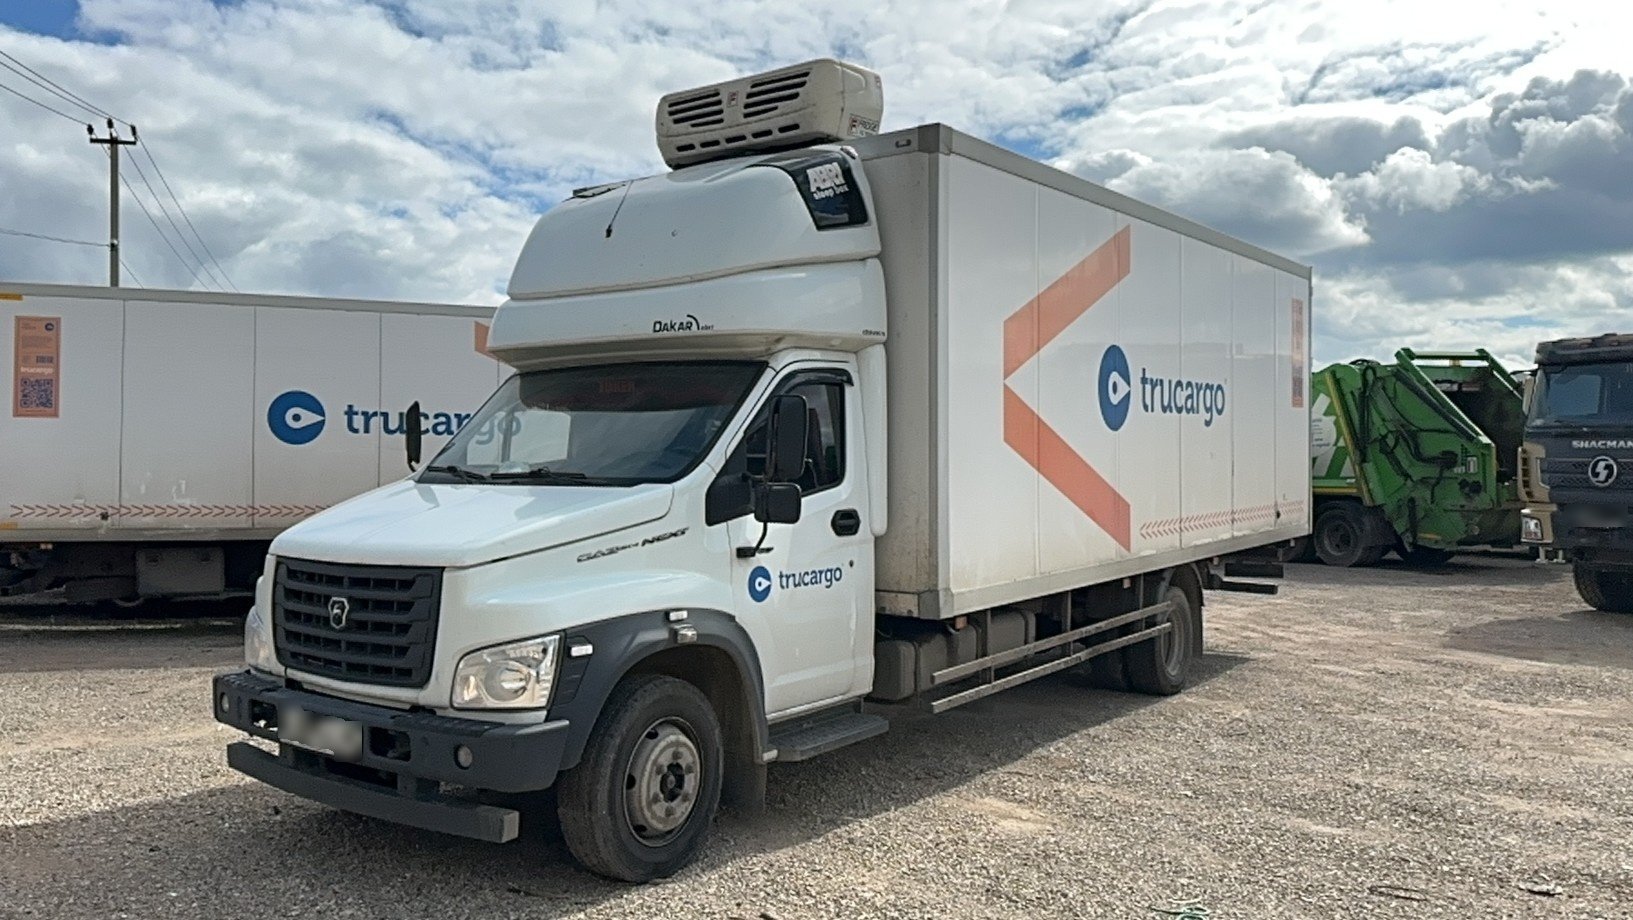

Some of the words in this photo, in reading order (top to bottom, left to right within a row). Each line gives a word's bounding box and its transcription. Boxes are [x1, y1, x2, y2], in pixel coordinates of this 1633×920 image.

[653, 319, 693, 333] DAKAR
[1140, 367, 1226, 428] trucargo
[1571, 440, 1633, 449] SHACMAN
[779, 566, 843, 590] trucargo
